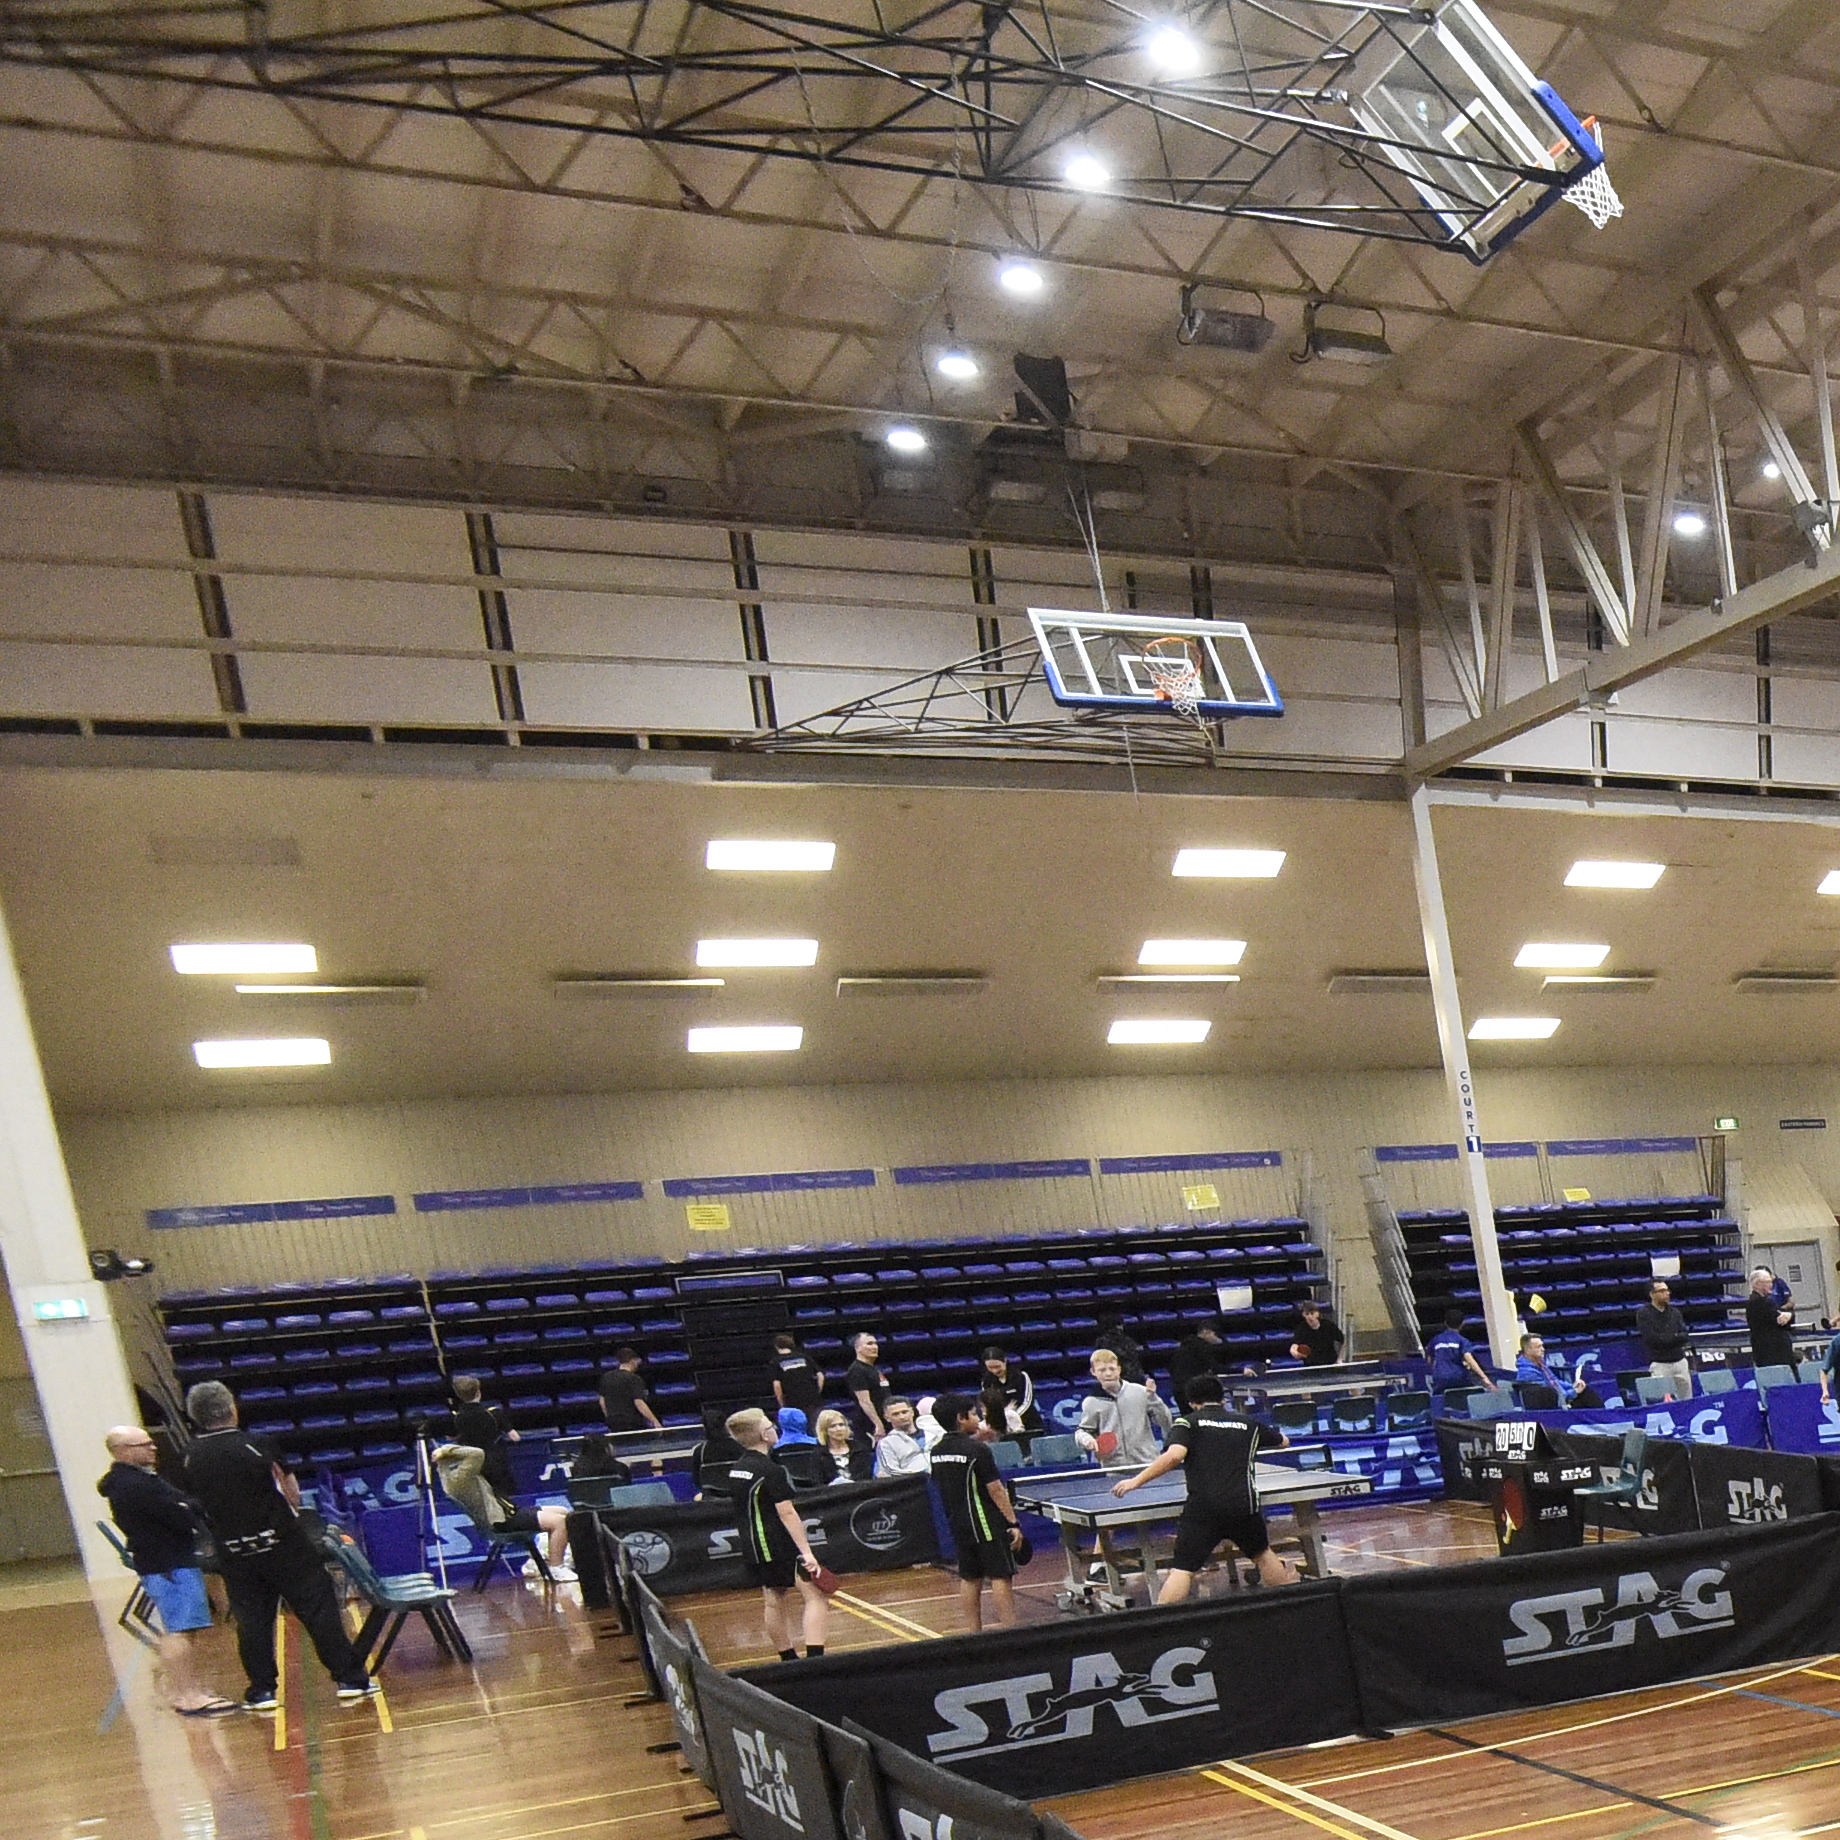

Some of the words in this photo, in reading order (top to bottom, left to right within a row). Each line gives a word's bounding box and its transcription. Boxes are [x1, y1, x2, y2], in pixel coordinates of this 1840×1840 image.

[1460, 1071, 1475, 1132] COURT
[1468, 1136, 1478, 1152] 1
[1527, 1426, 1534, 1449] 0
[1330, 1486, 1362, 1495] STAG
[1560, 1467, 1592, 1480] STAG
[1728, 1477, 1787, 1524] STAG
[1504, 1568, 1735, 1665] STAG
[928, 1645, 1219, 1758] STAG
